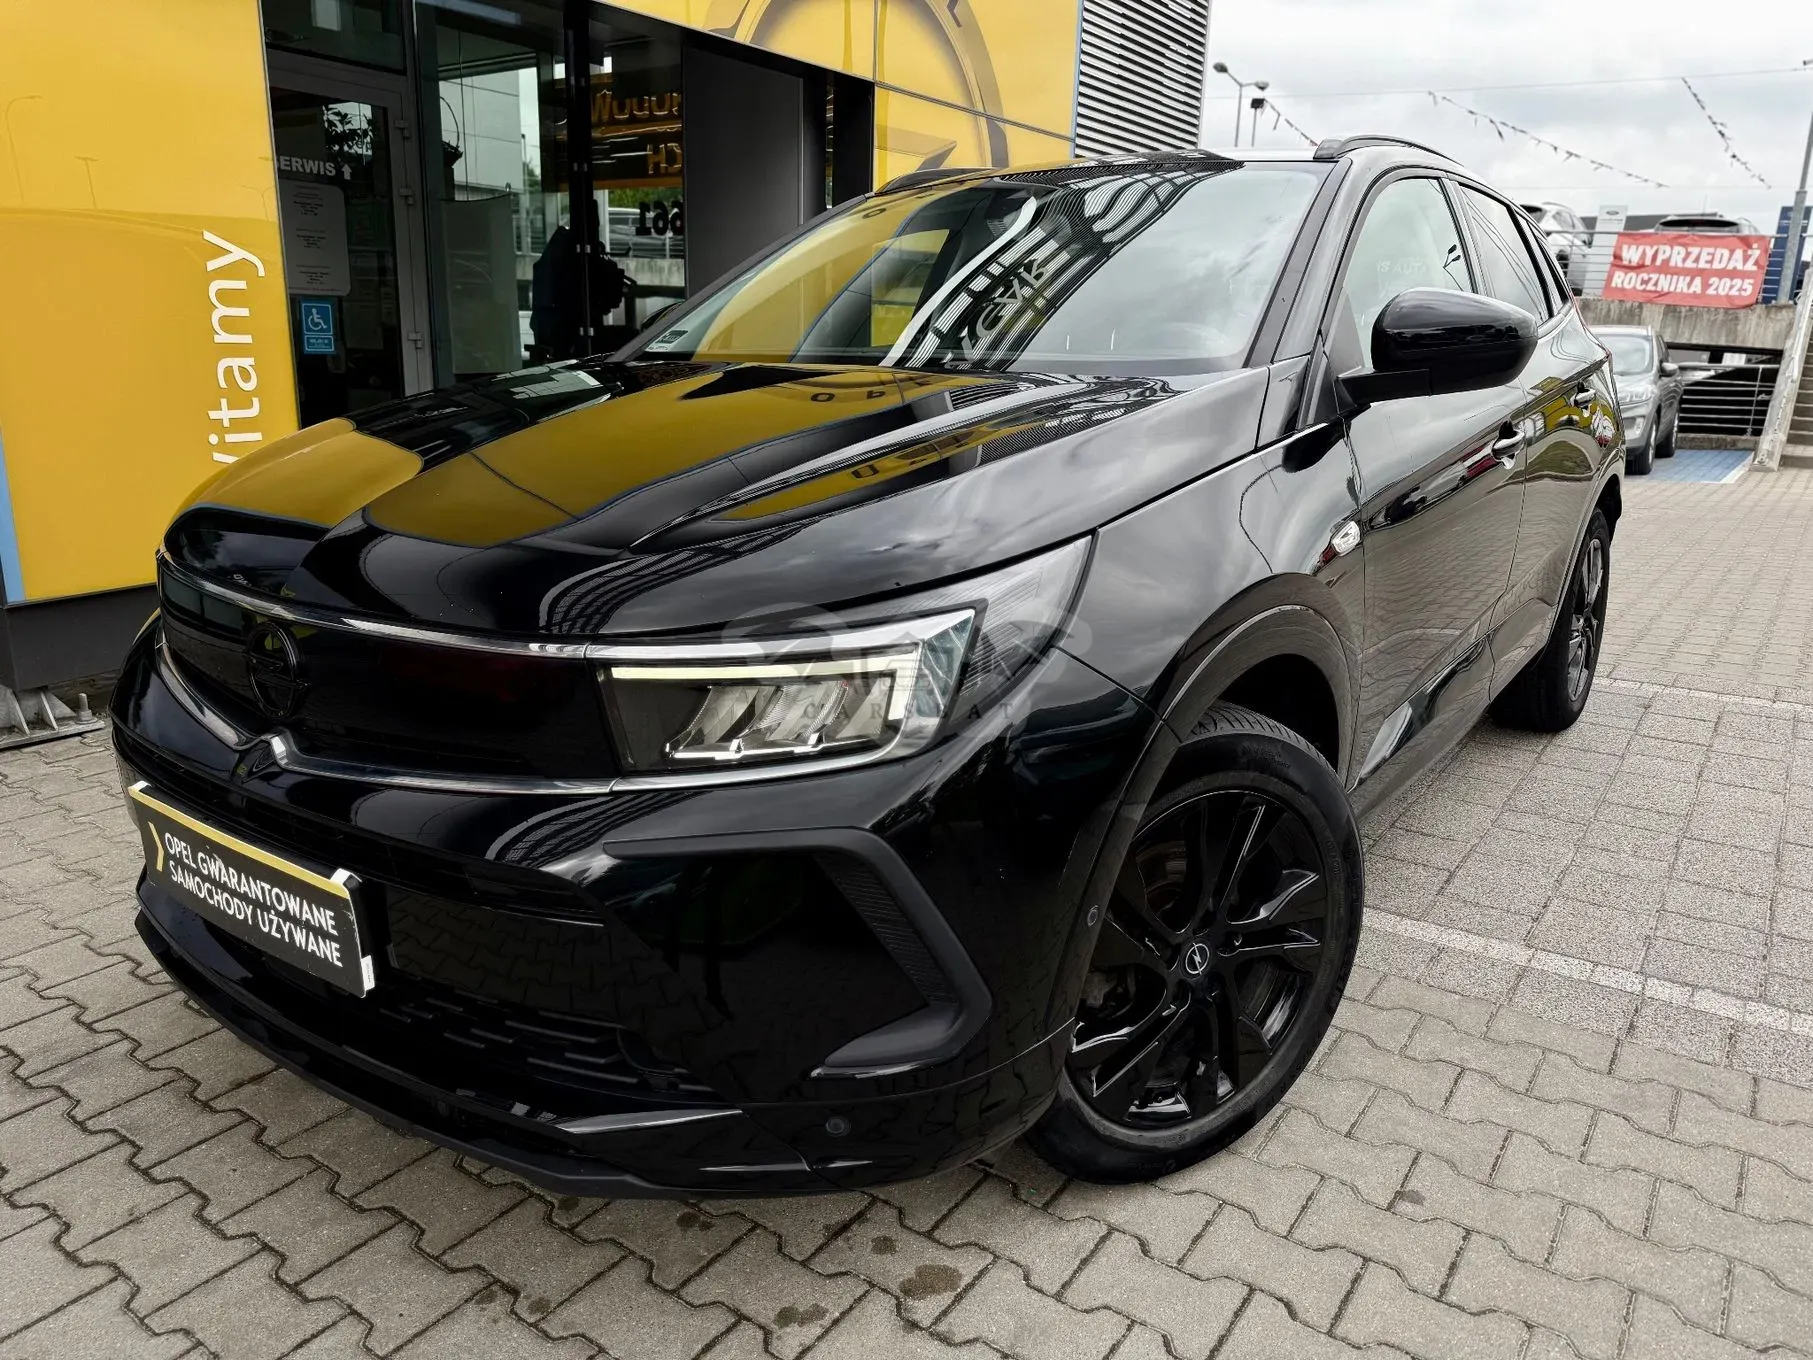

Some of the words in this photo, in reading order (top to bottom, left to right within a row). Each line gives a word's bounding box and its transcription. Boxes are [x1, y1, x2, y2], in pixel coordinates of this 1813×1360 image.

[276, 155, 336, 177] ERWIS
[1621, 243, 1761, 271] WYPRZEDAŻ
[1611, 270, 1702, 294] ROCZNIKA
[1705, 276, 1755, 297] 2025
[164, 832, 198, 870] OPEL
[197, 851, 339, 937] GWARANTOWANE
[169, 860, 253, 926] SAMOCHODY
[256, 907, 344, 968] UŻYWANE
